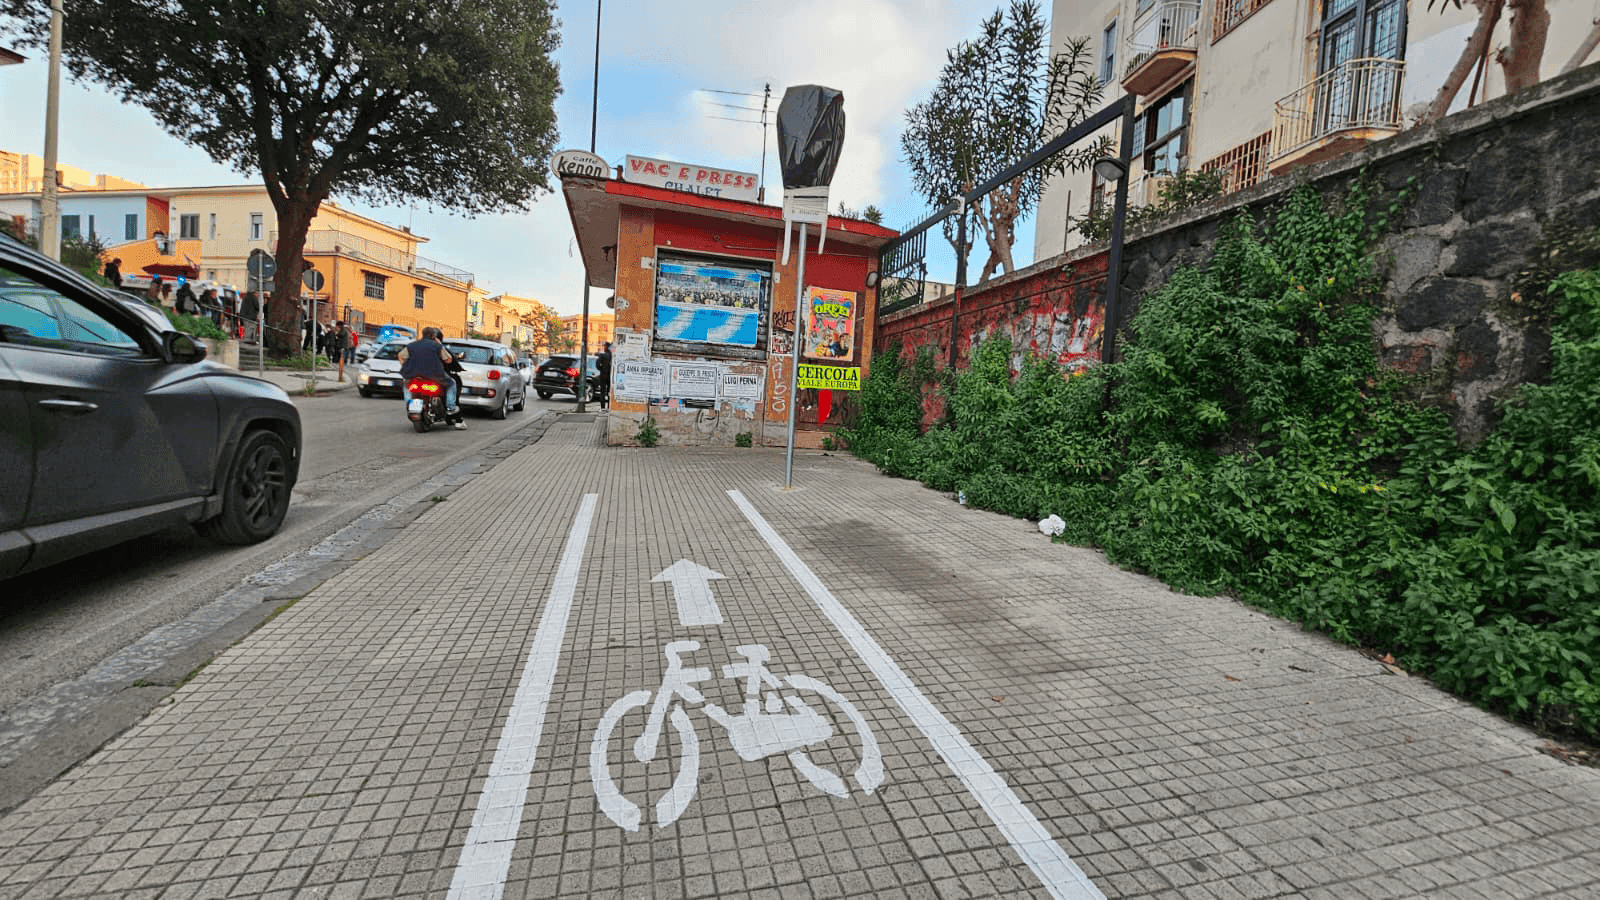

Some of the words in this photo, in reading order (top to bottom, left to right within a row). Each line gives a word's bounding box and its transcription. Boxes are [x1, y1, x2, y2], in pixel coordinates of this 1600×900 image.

[630, 159, 670, 176] VAC
[678, 167, 689, 180] E
[696, 169, 756, 189] PRESS
[797, 366, 858, 381] CERCOLA
[725, 376, 738, 385] LUIGI
[740, 377, 757, 385] PERNA
[824, 379, 857, 389] EUROPA
